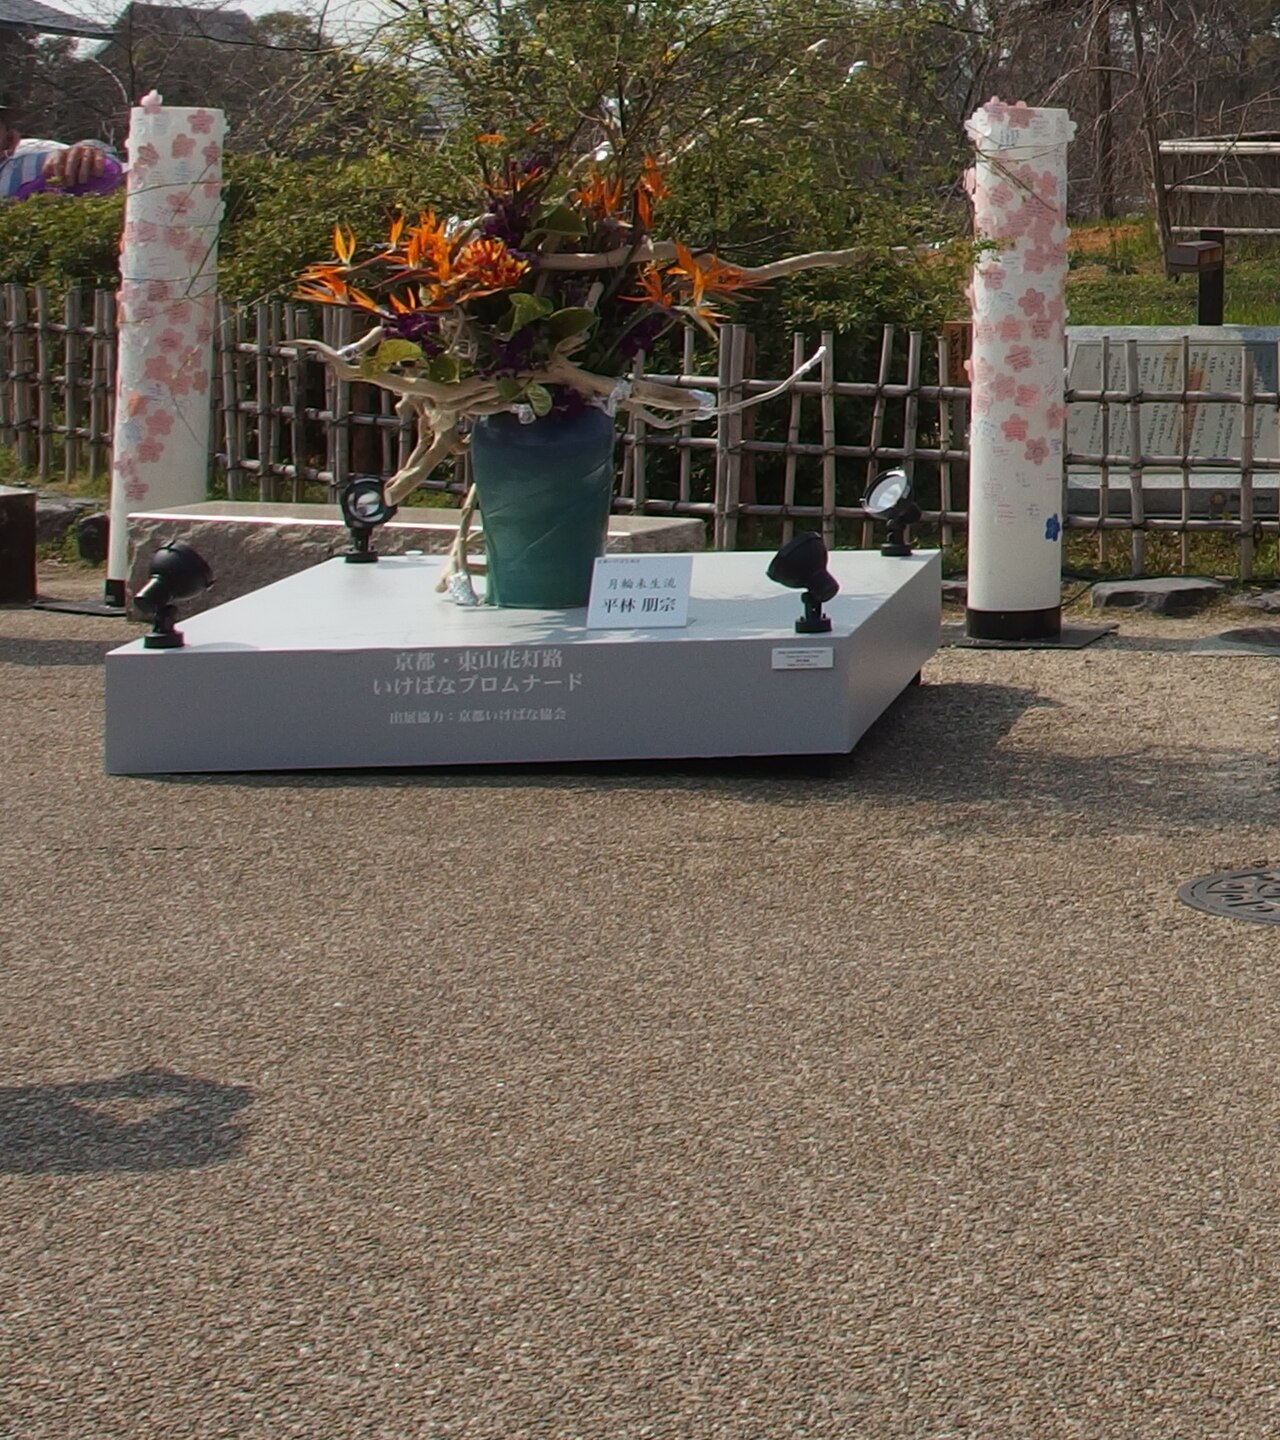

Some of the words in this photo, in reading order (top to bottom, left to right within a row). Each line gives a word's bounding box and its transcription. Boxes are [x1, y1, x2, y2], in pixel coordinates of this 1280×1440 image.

[603, 597, 636, 613] 平林
[641, 597, 677, 612] 朋宗
[393, 648, 564, 672] 京都・東山花灯路
[372, 673, 584, 696] いけばなプロムナード
